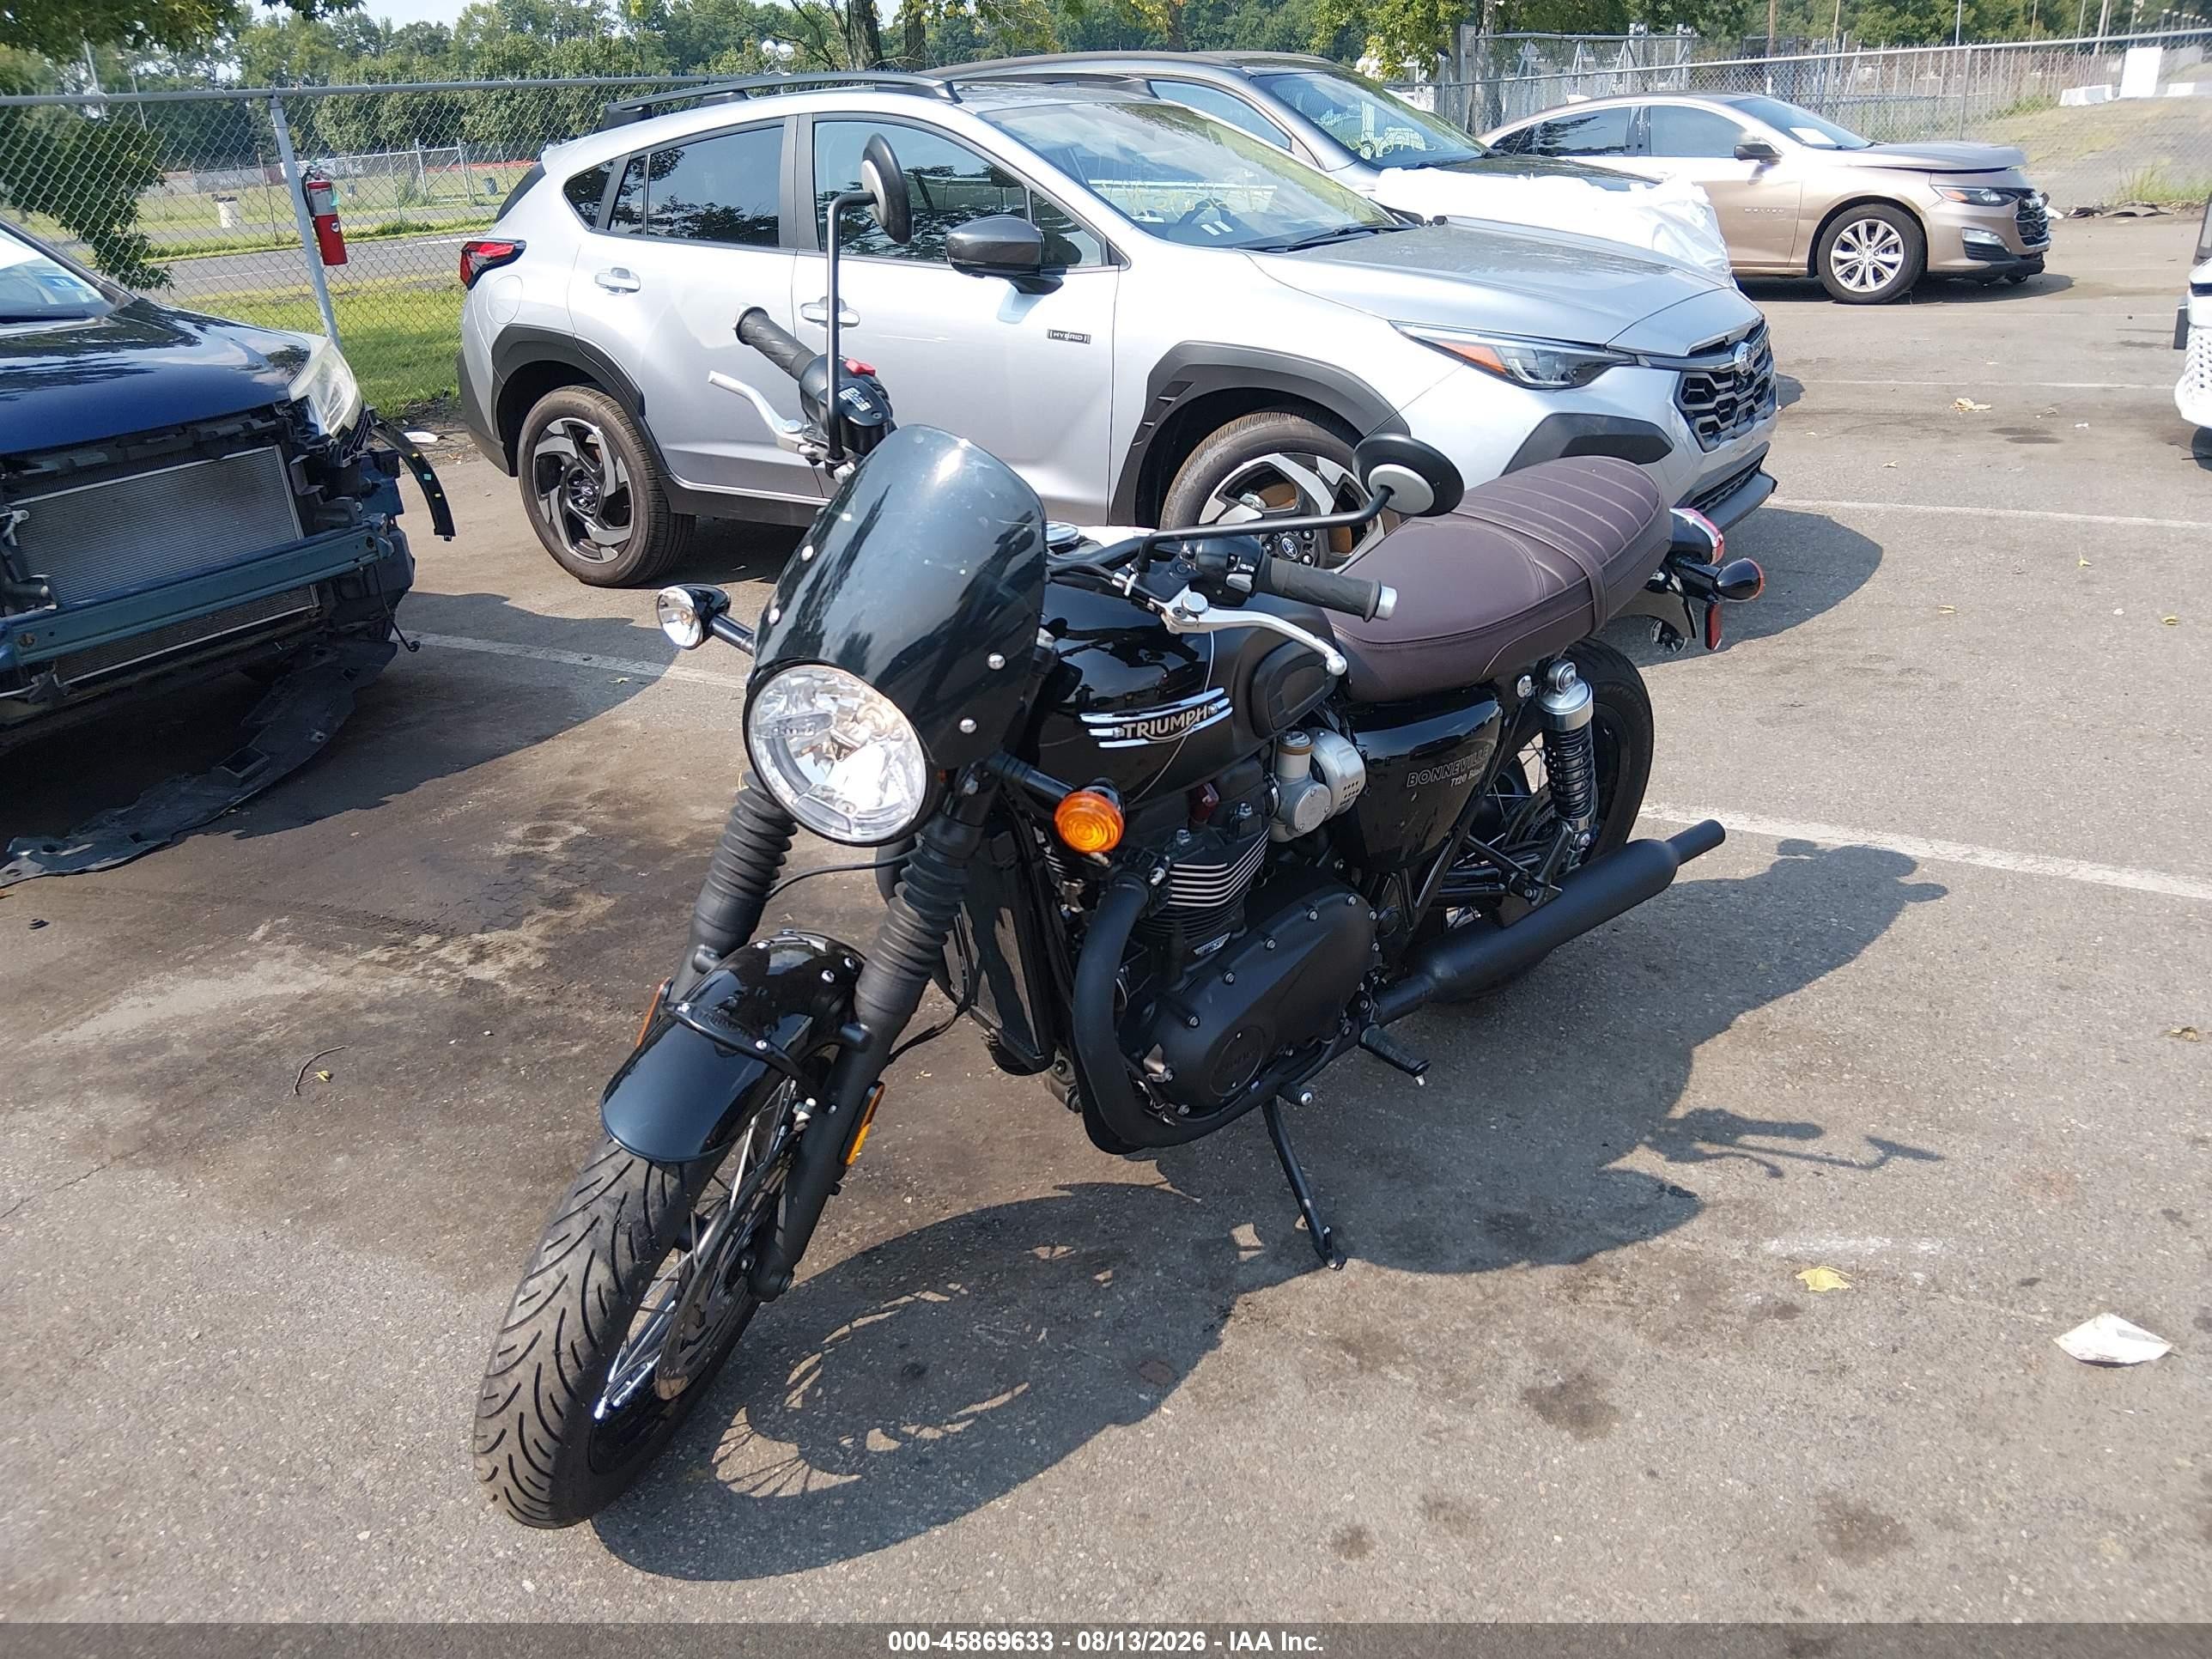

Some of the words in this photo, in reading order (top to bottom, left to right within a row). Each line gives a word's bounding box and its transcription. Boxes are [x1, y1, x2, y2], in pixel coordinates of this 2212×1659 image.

[1053, 331, 1084, 341] HYBRID
[1122, 705, 1208, 740] TRIUMPH
[1407, 744, 1491, 787] BONNEVILLE
